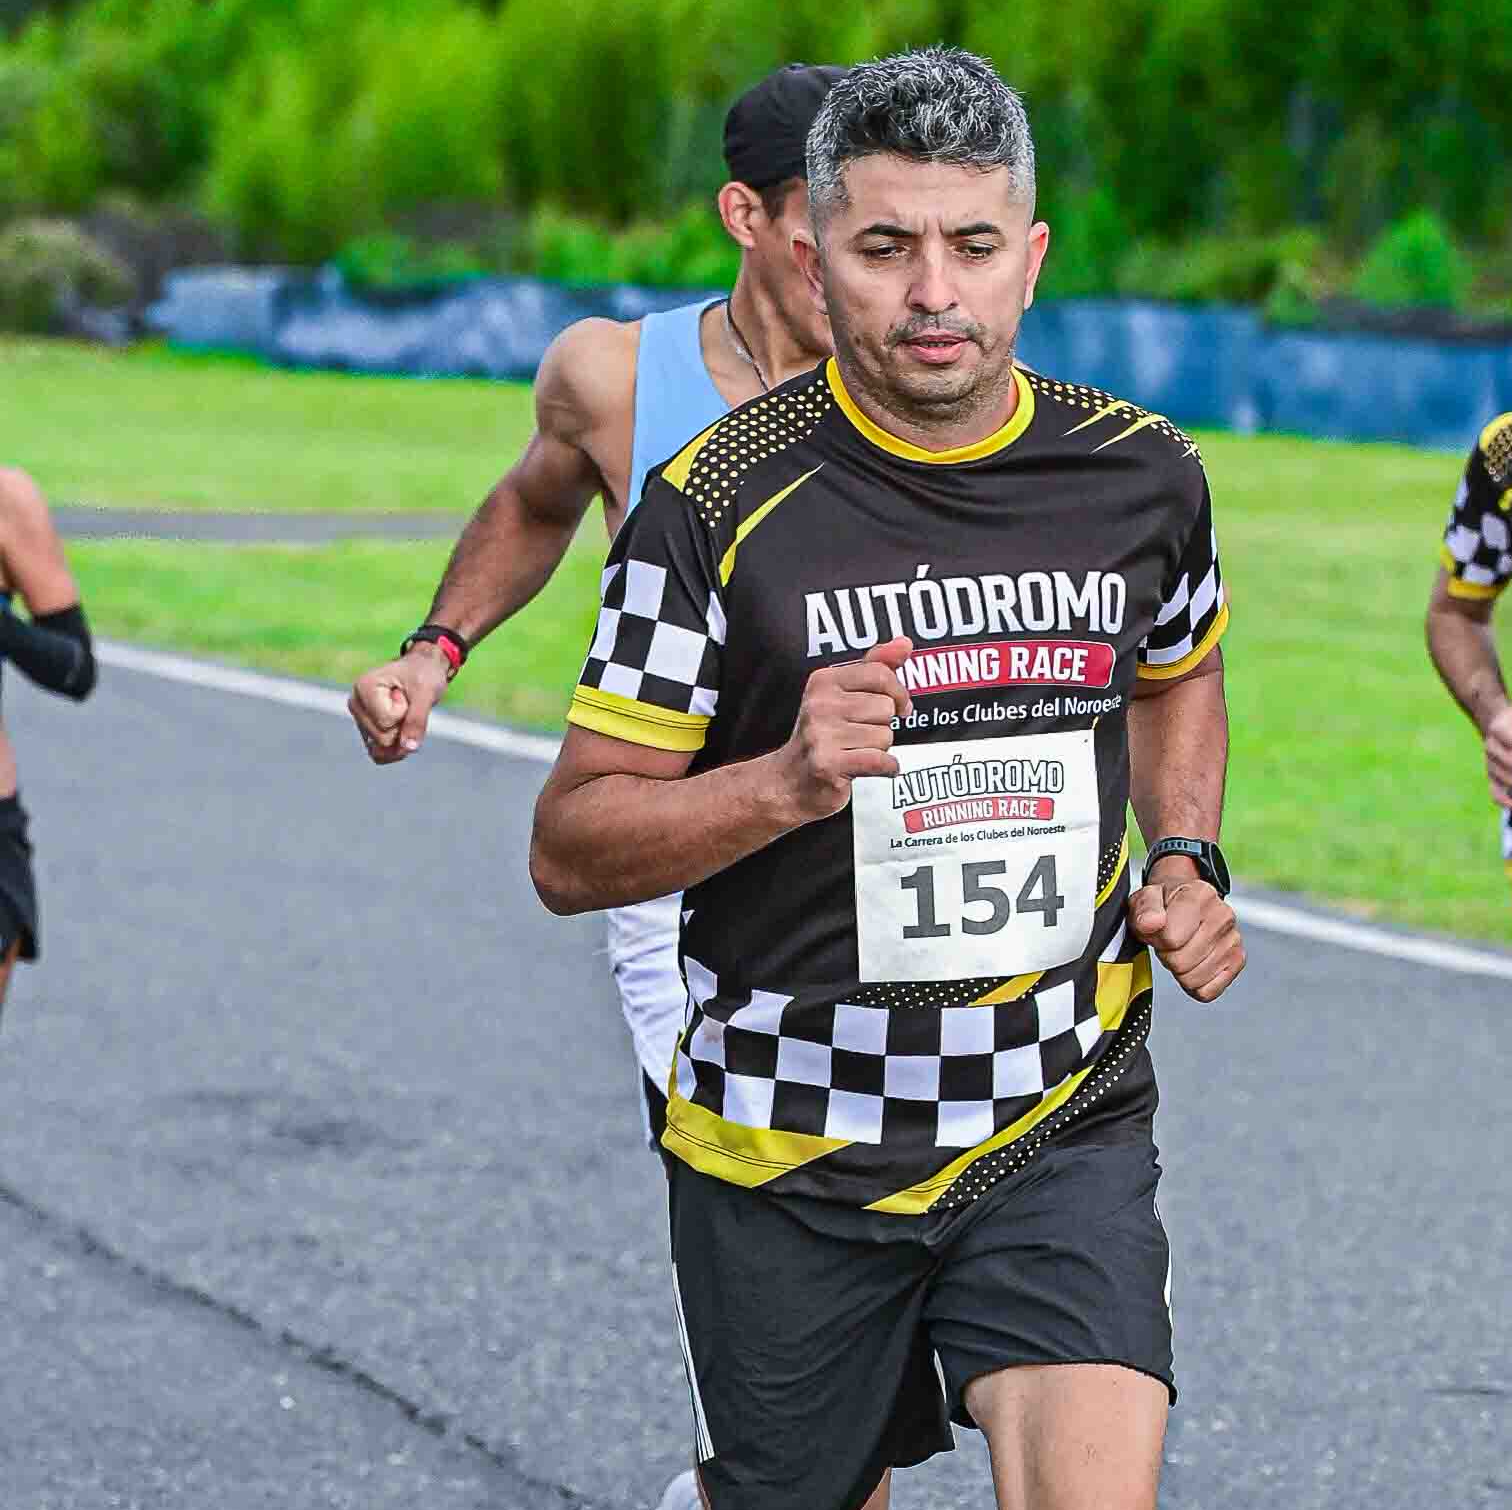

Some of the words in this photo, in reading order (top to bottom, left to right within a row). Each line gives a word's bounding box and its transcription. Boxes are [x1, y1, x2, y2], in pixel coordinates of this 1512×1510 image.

[804, 564, 1127, 659] AUTÓDROMO
[896, 647, 1001, 691] NNING
[1008, 646, 1089, 683] RACE
[905, 709, 929, 729] de
[933, 707, 959, 726] los
[962, 701, 1027, 724] Clubes
[1031, 697, 1060, 718] del
[892, 754, 1065, 810] AUTÓDROMO
[921, 799, 994, 829] RUNNING
[998, 798, 1039, 819] RACE
[890, 838, 902, 849] La
[904, 836, 944, 848] Carrera
[945, 833, 959, 844] de
[960, 831, 975, 843] los
[976, 828, 1009, 841] Clubes
[1010, 826, 1025, 838] del
[1026, 824, 1066, 836] Noroeste
[900, 854, 1065, 939] 154
